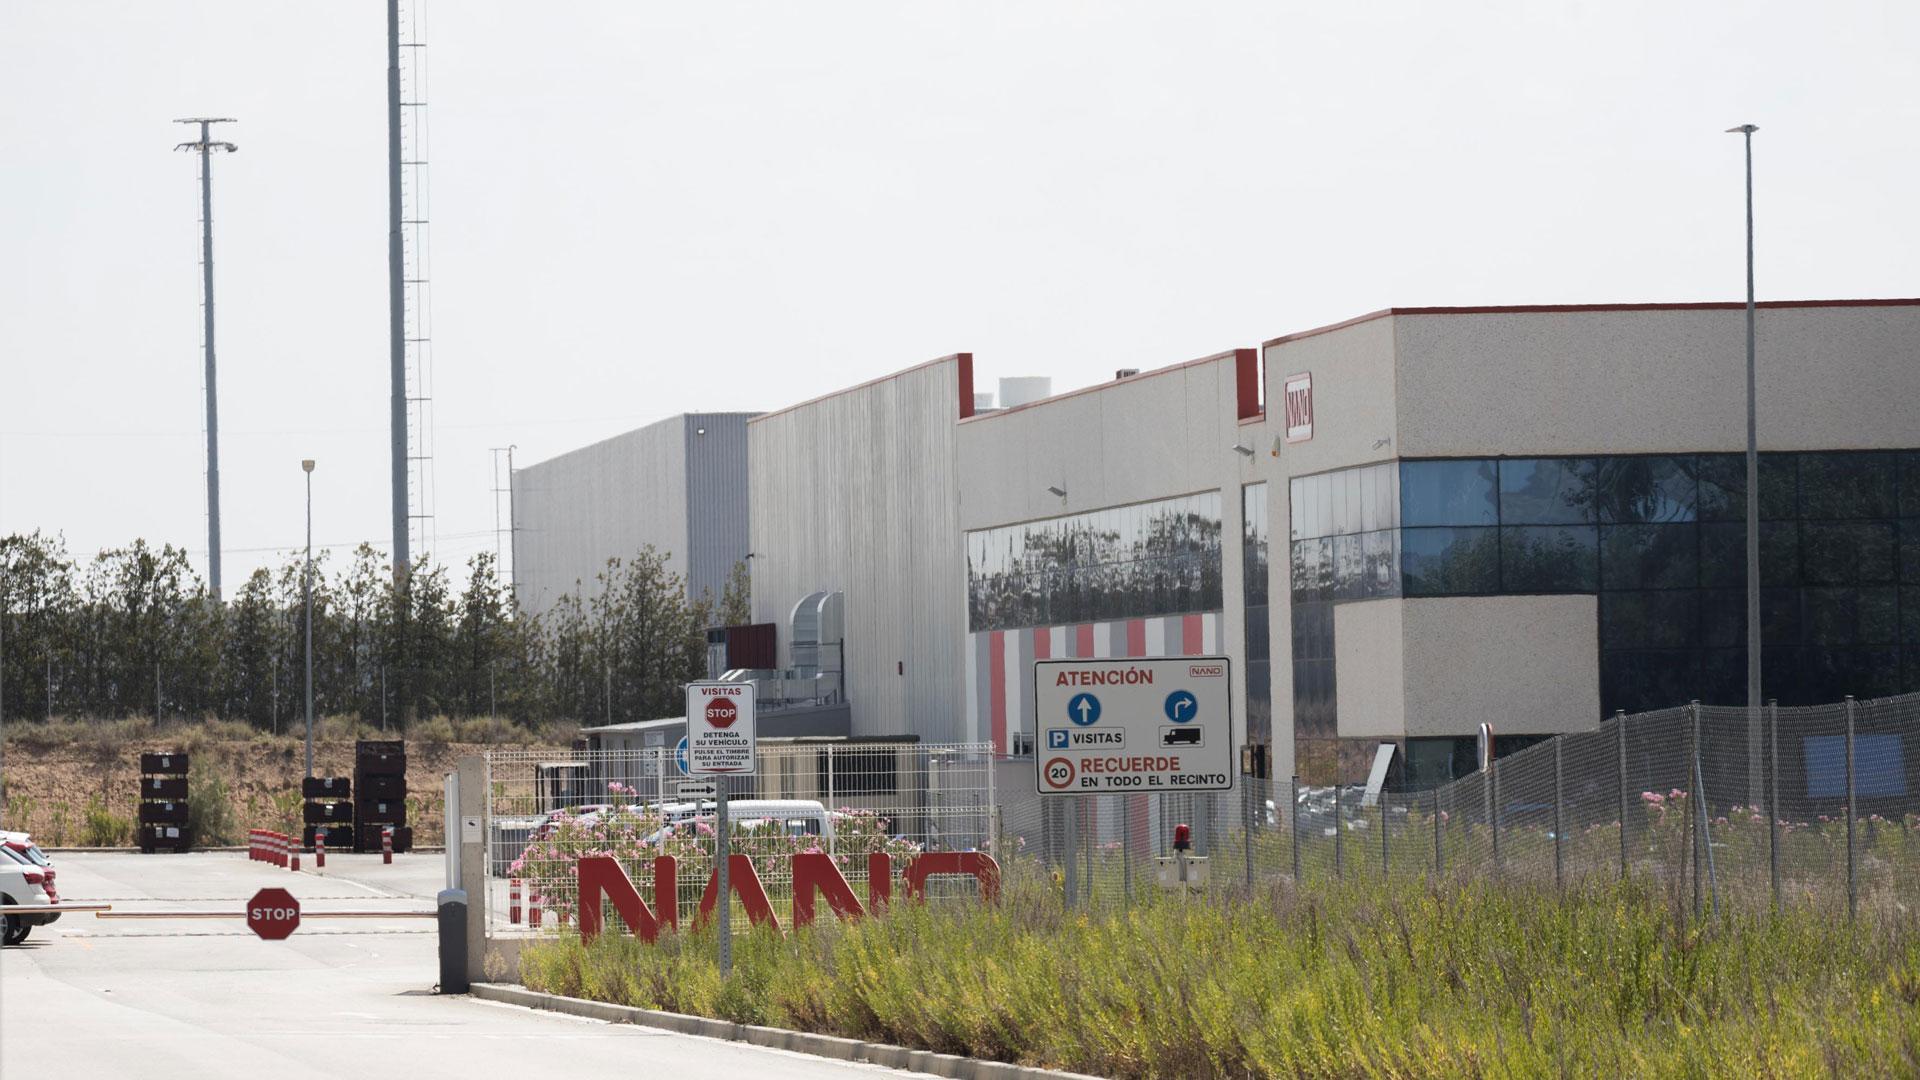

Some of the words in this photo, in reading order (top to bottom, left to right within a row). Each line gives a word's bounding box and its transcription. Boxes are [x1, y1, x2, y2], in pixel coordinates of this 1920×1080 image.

[1056, 667, 1153, 686] ATENCIÓN
[1191, 668, 1221, 676] NANO
[701, 688, 742, 696] VISITAS
[707, 708, 736, 718] STOP
[709, 738, 748, 746] VEHÍCULO
[1053, 732, 1066, 747] P
[1073, 732, 1123, 745] VISITAS
[1080, 756, 1181, 774] RECUERDE
[1051, 767, 1068, 779] 20
[1081, 777, 1098, 787] EN
[1105, 776, 1142, 787] TODO
[1148, 775, 1163, 786] EL
[1170, 774, 1226, 785] RECINTO
[252, 908, 296, 921] STOP
